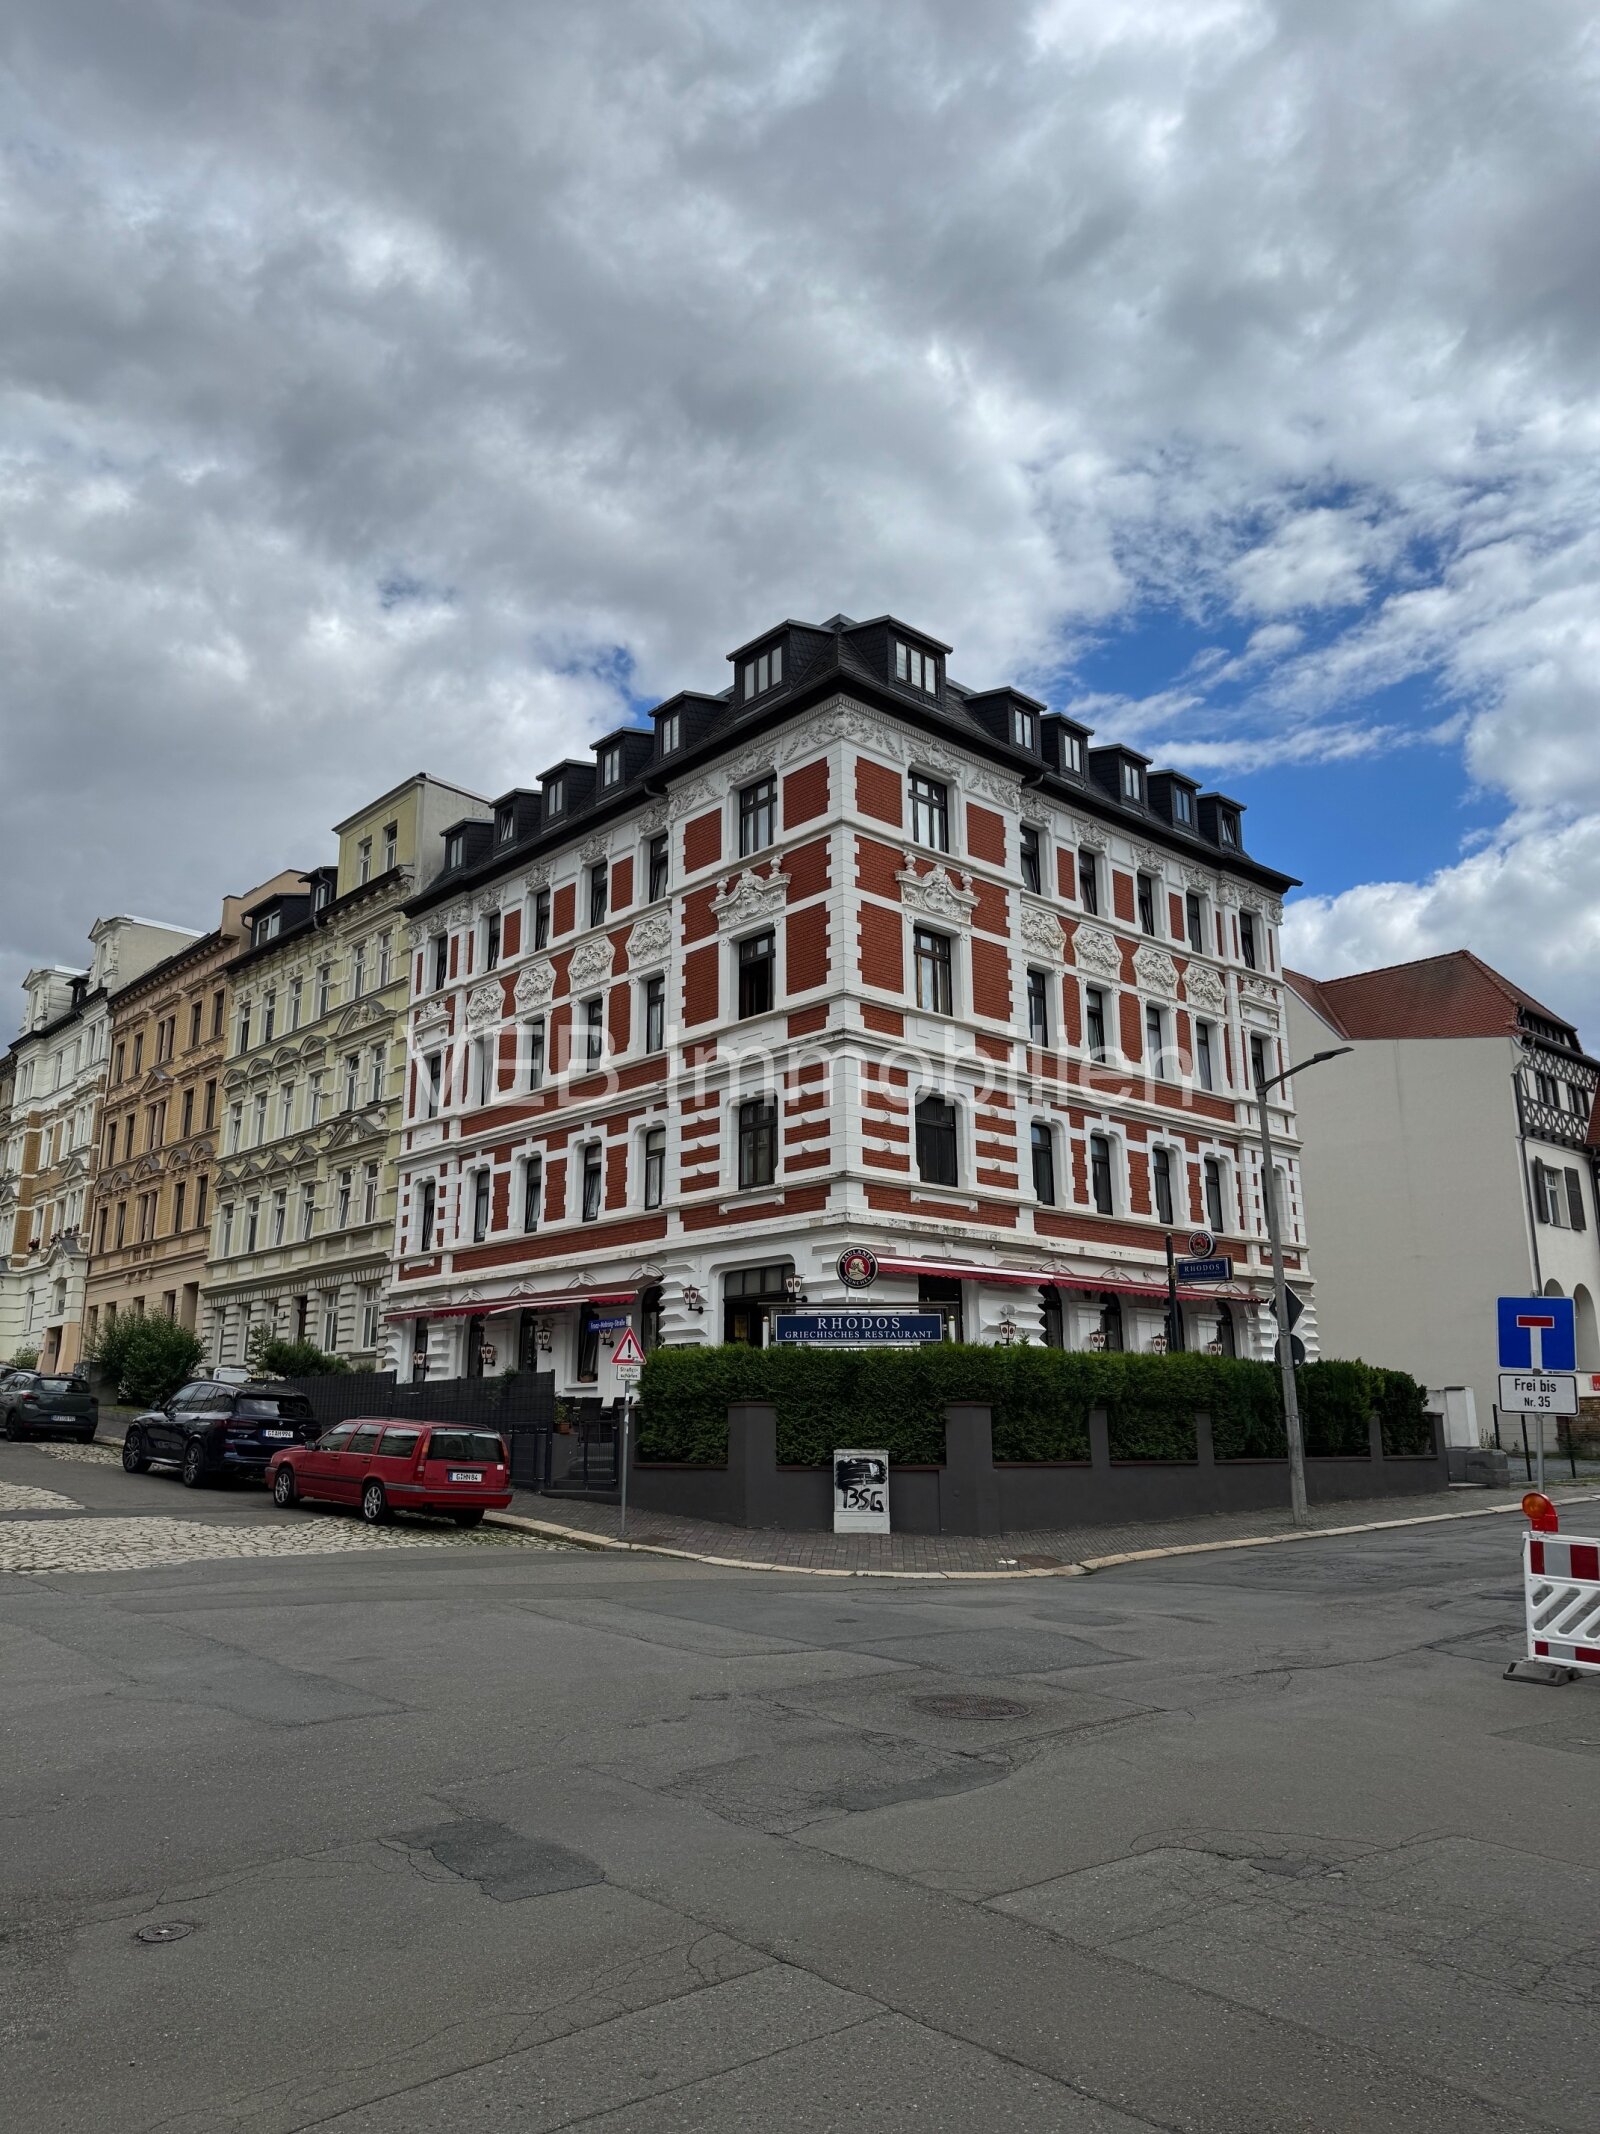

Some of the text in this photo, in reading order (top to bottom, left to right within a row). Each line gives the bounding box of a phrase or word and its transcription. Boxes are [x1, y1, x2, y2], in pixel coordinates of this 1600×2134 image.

[841, 1249, 873, 1263] PAULANER
[1184, 1264, 1220, 1272] RHODOS
[817, 1317, 901, 1329] RHODOS
[784, 1330, 934, 1339] GRIECHISCHES RESTAURANT
[1514, 1378, 1557, 1393] Frei bis
[1524, 1396, 1551, 1408] Nr. 35
